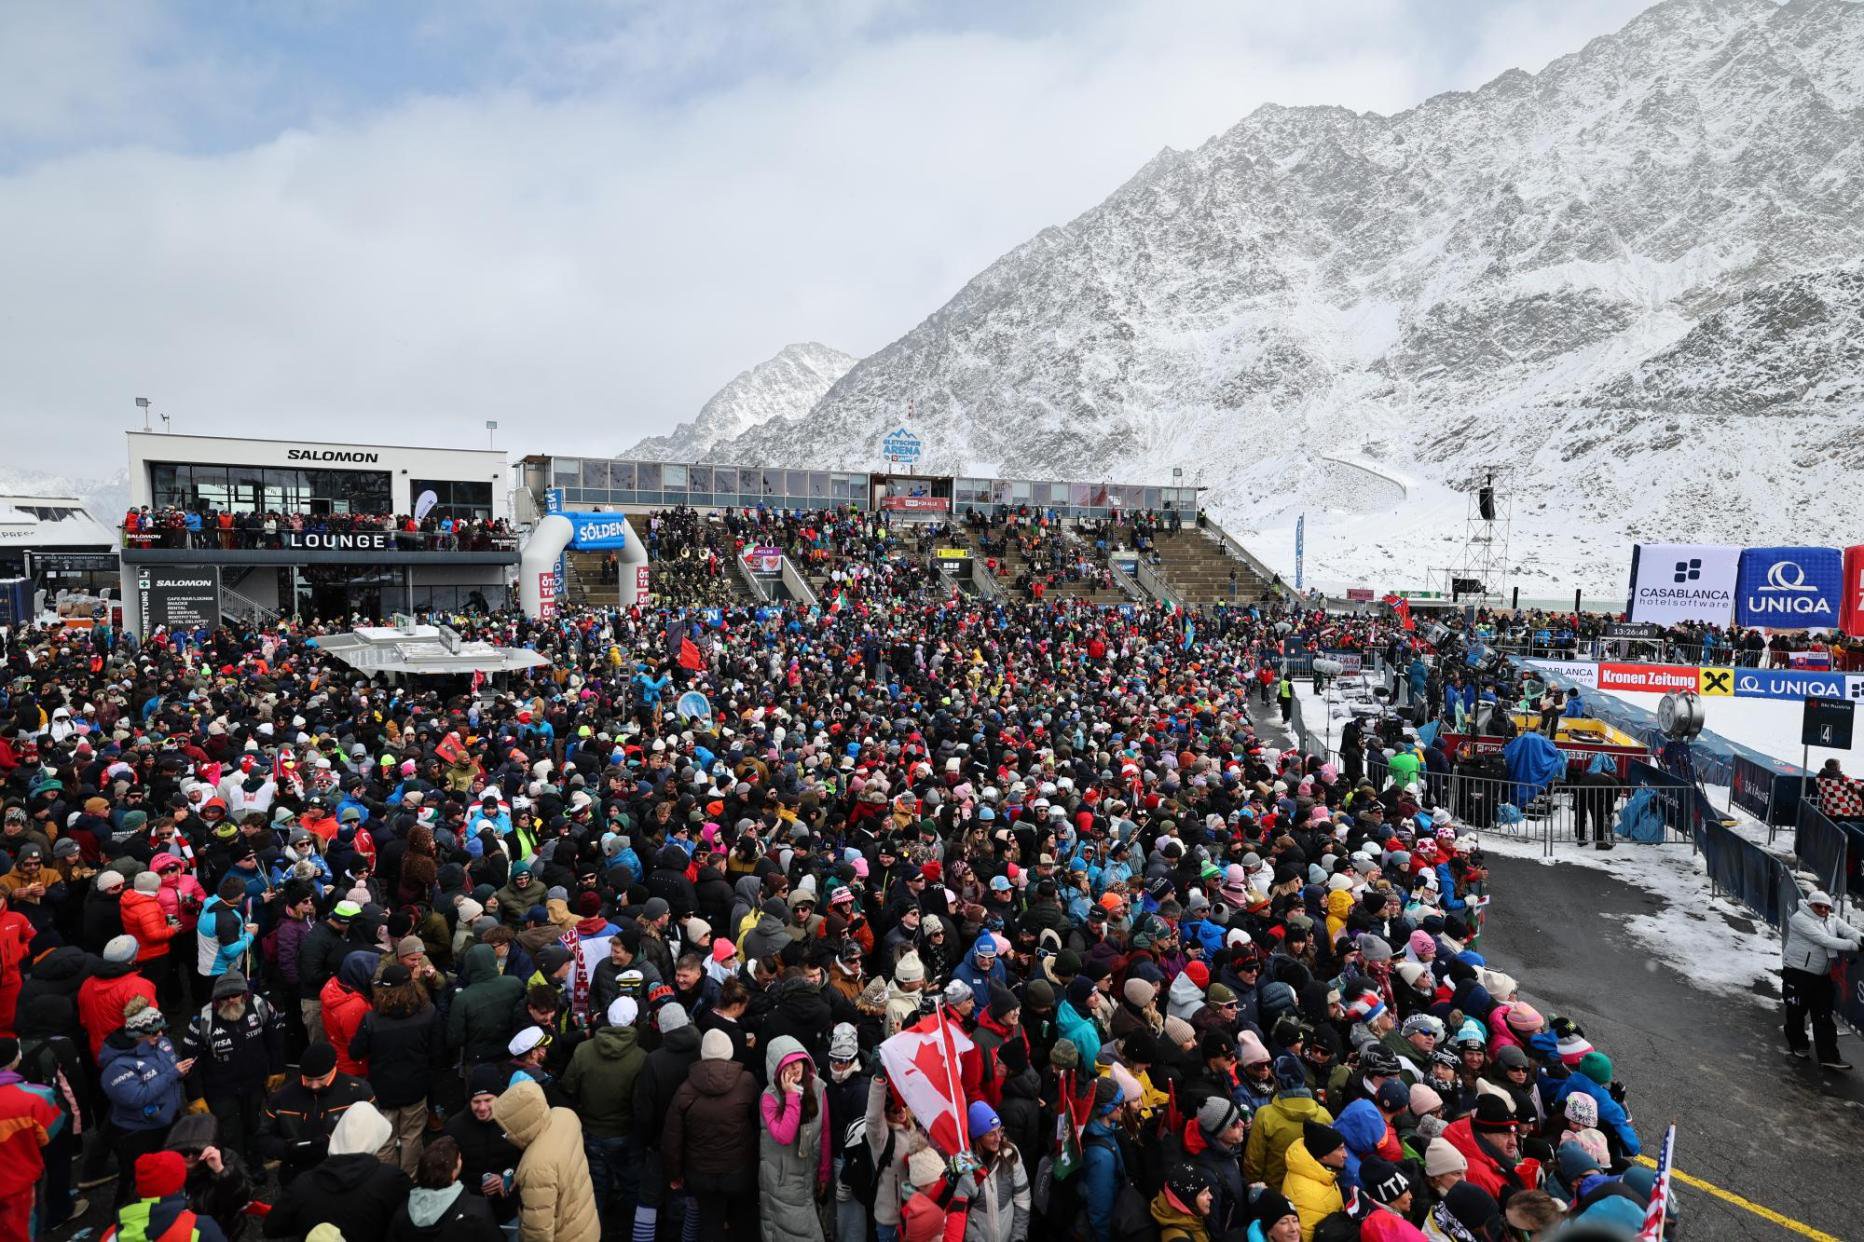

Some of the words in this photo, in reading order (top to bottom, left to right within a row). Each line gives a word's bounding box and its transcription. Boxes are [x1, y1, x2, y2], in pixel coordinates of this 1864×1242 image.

[288, 449, 378, 463] SALOMON
[883, 446, 921, 455] ARENA
[580, 521, 624, 541] SÖLDEN
[291, 534, 385, 548] LOUNGE
[542, 575, 554, 586] ÖT
[638, 569, 649, 579] ÖT
[1640, 588, 1729, 600] CASABLANCA
[543, 605, 555, 616] ÖT
[1640, 598, 1729, 609] hotelsoftware
[1749, 597, 1831, 613] UNIQA
[141, 591, 149, 634] ENRETTUNG
[1614, 628, 1649, 636] 13:26:48
[1602, 669, 1646, 684] Kronen
[1647, 672, 1696, 688] Zeitung
[1770, 680, 1841, 697] UNIQA
[1822, 726, 1831, 743] 4
[1377, 1171, 1409, 1201] ITA
